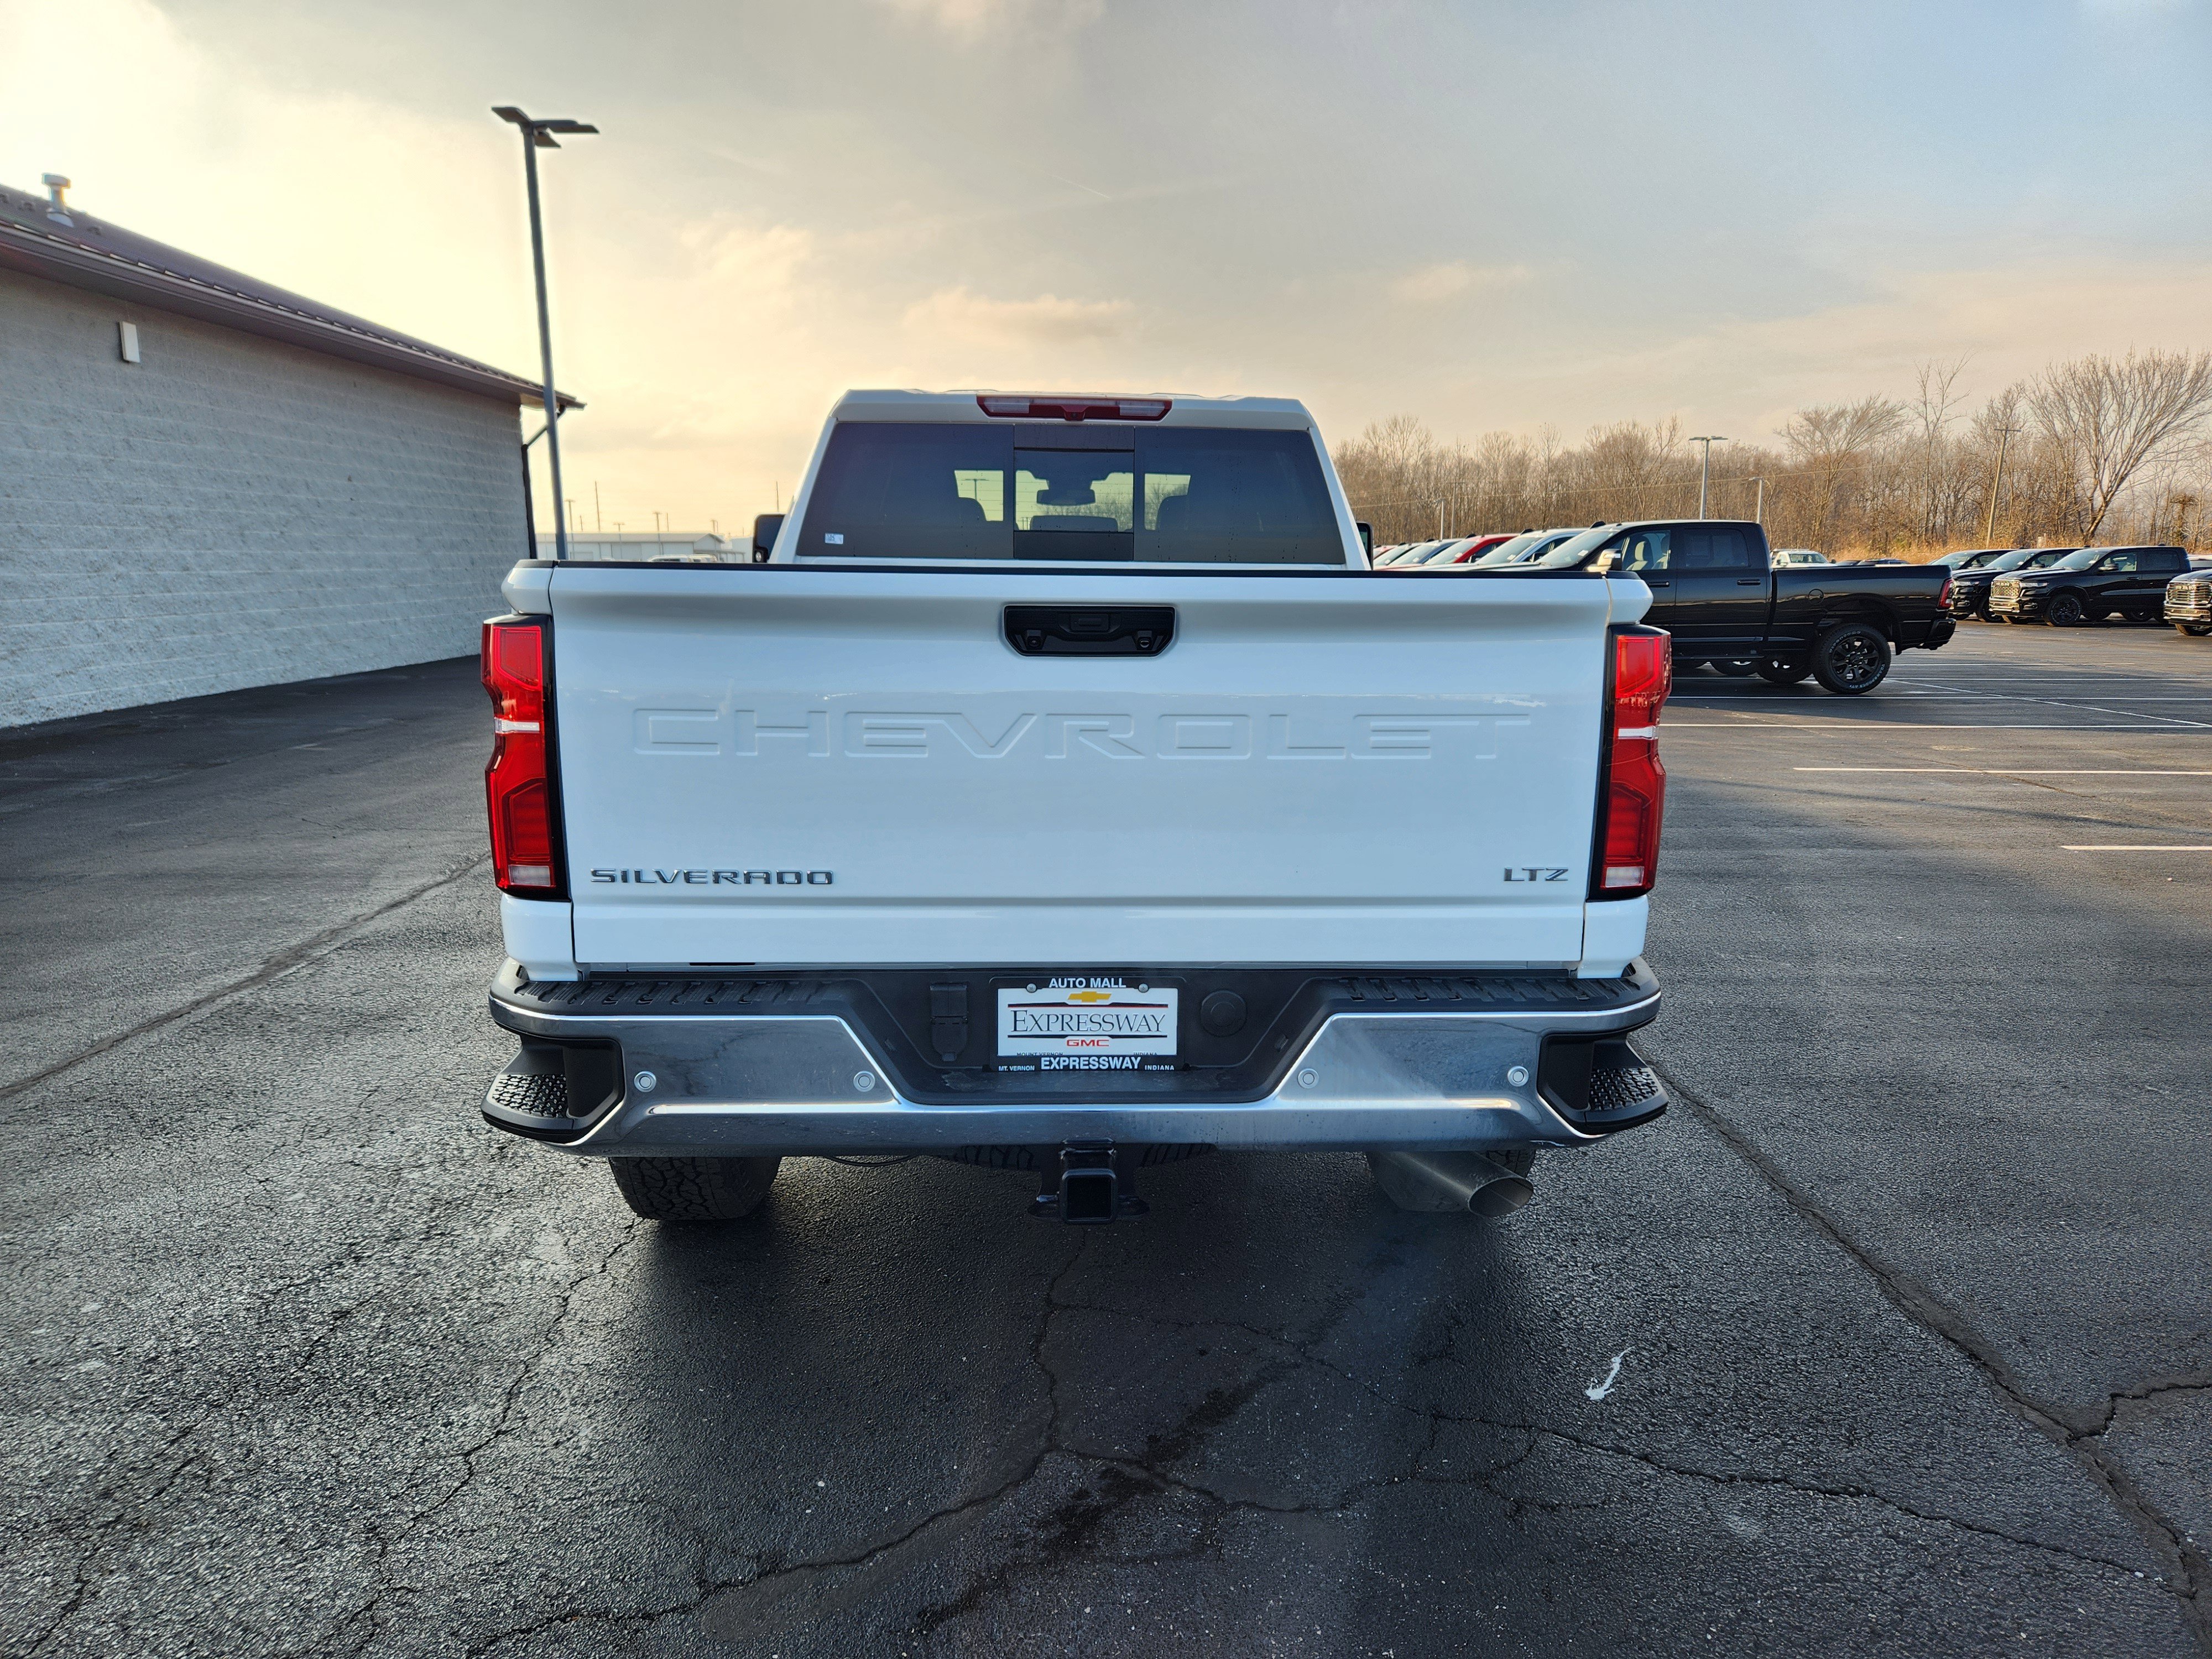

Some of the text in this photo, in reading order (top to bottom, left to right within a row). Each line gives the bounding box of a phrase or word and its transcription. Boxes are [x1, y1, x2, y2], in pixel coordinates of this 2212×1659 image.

[633, 709, 1531, 759] CHEVROLET
[590, 868, 834, 885] SILVERADO
[1504, 867, 1568, 881] LTZ
[1048, 978, 1126, 988] AUTO MALL
[1010, 1010, 1166, 1032] EXPRESSWAY
[1041, 1057, 1141, 1070] EXPRESSWAY
